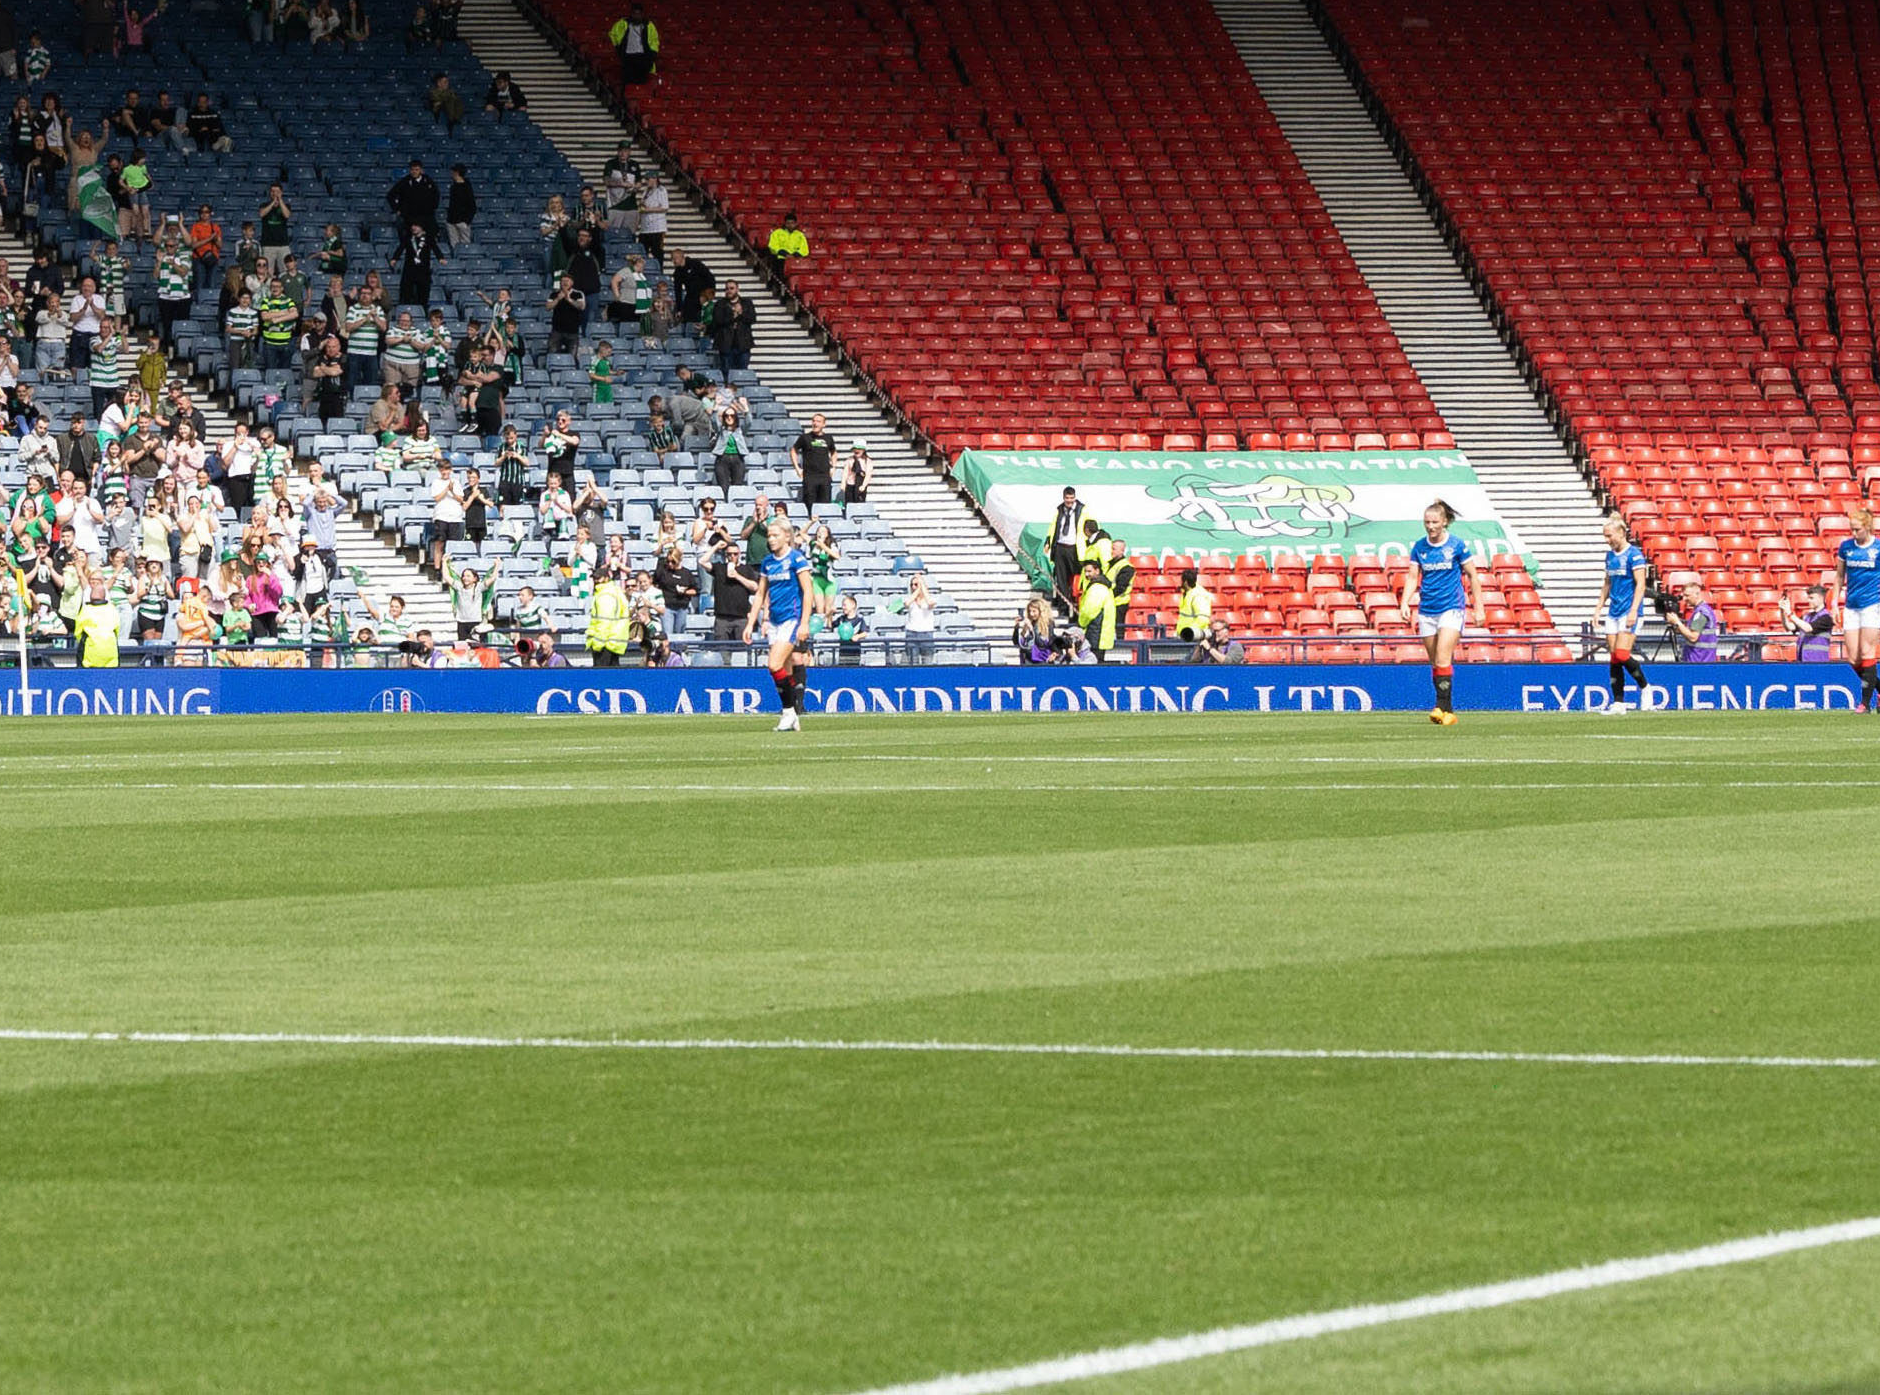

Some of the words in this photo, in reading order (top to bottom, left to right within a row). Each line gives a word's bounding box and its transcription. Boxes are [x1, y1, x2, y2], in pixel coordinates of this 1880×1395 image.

[536, 688, 648, 715] CSD
[672, 687, 762, 714] AIR
[1253, 686, 1373, 713] LTD
